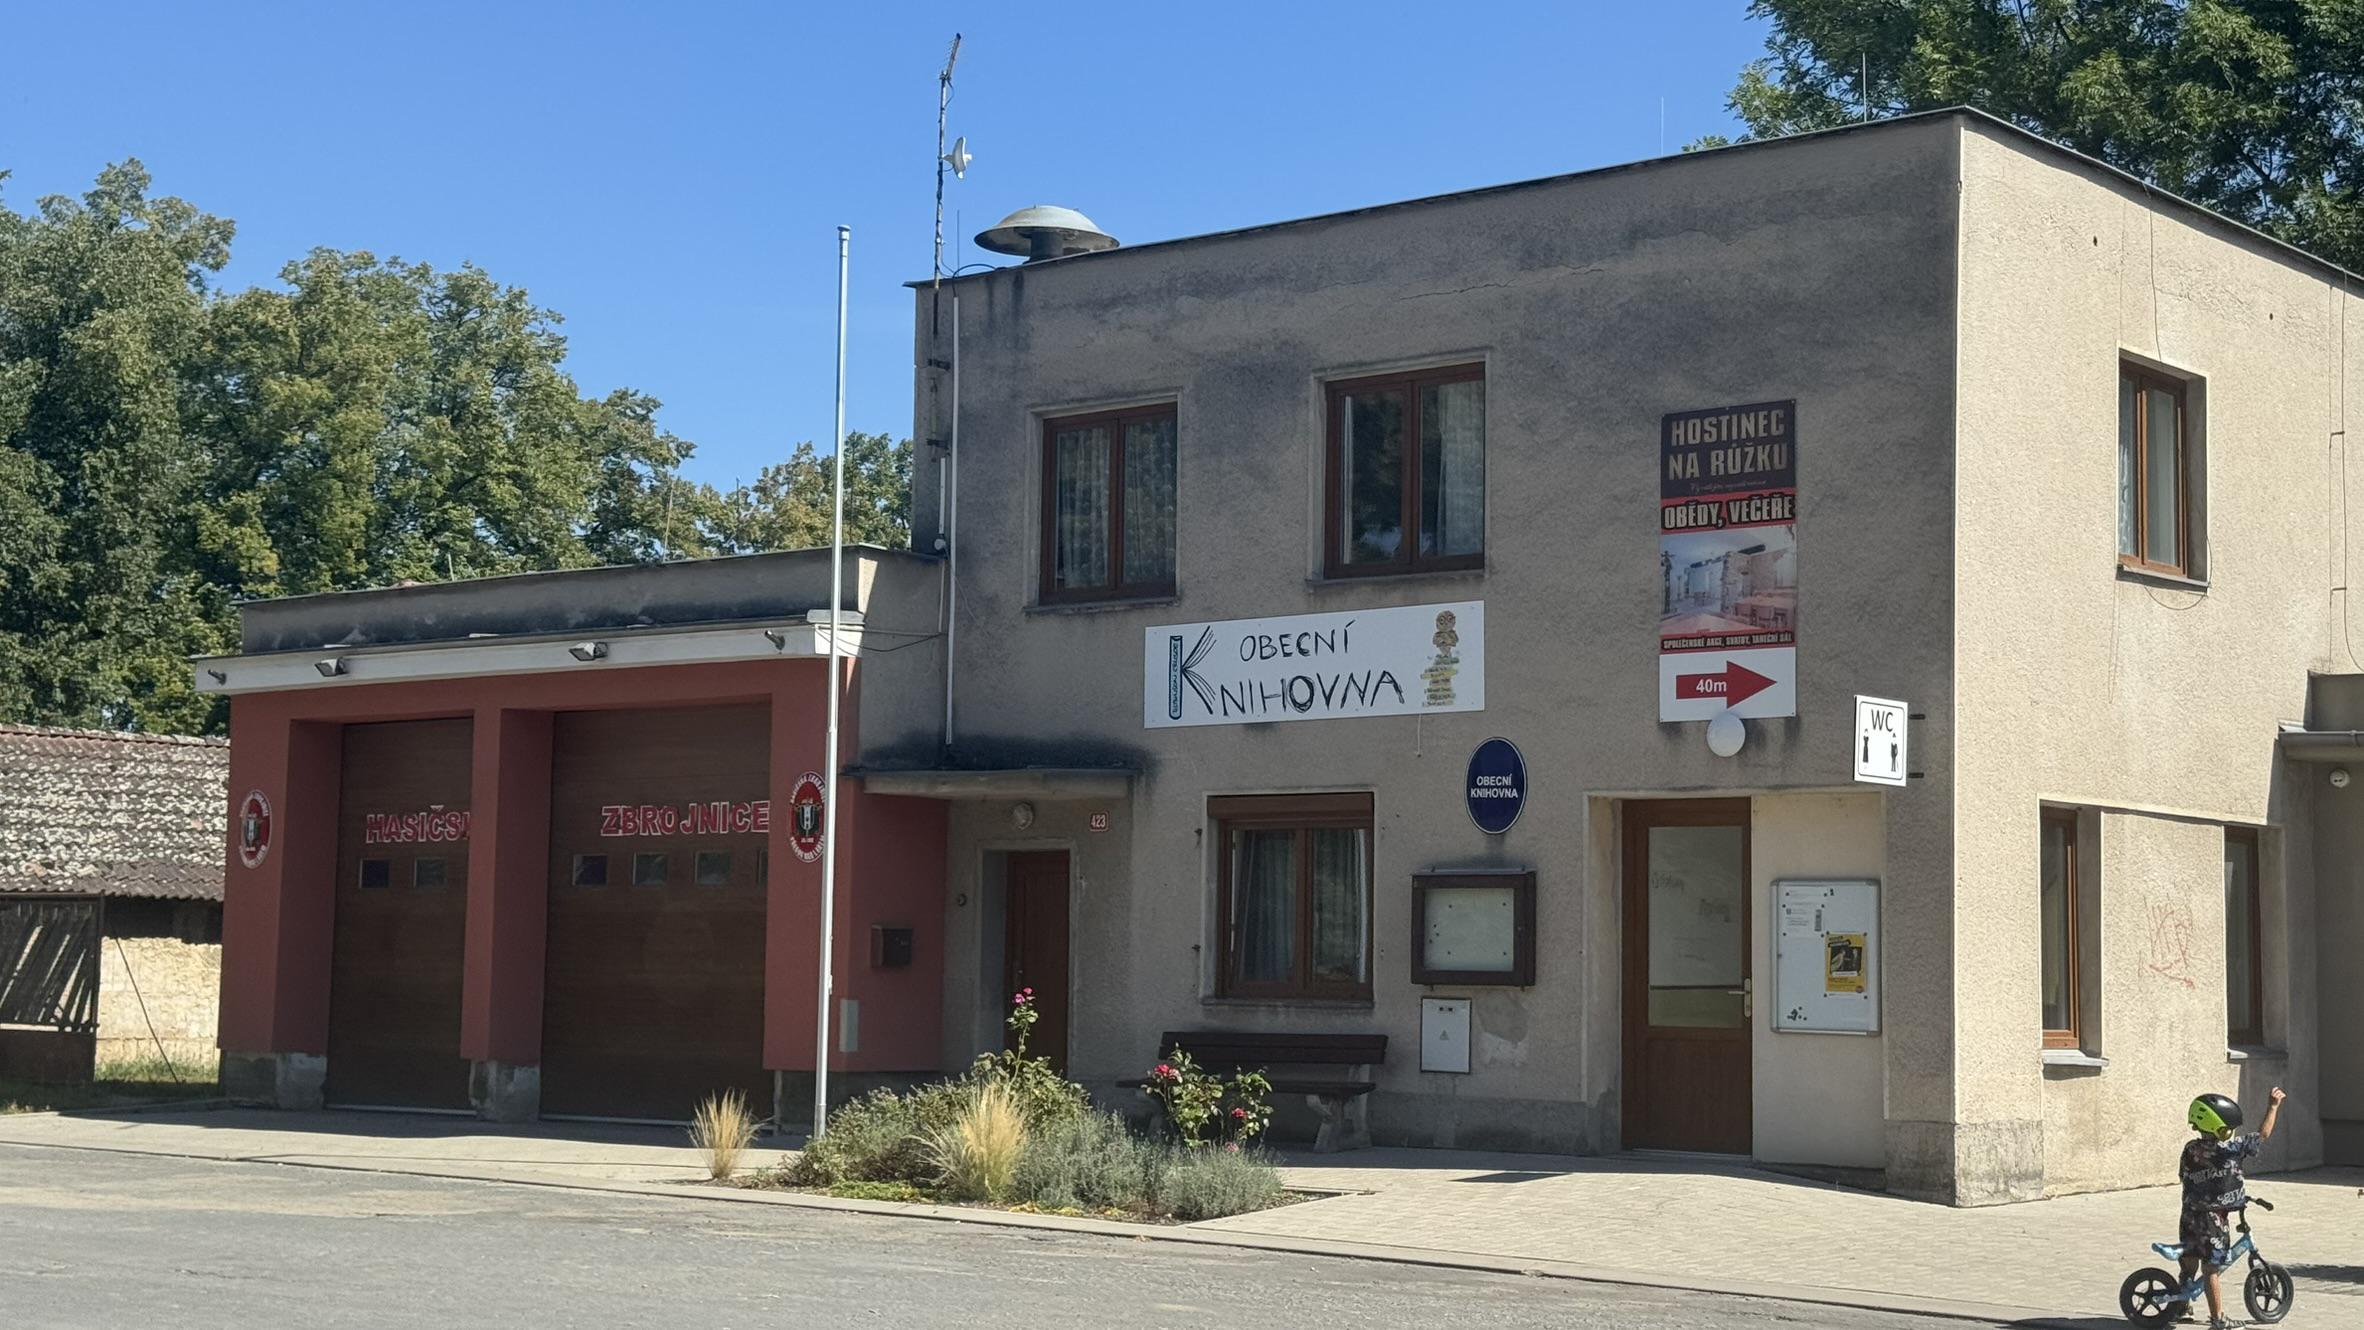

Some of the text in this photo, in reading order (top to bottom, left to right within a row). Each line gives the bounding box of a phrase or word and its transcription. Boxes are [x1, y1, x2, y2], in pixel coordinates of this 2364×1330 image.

[1671, 409, 1785, 446] HOSTINEC
[1668, 452, 1700, 480] NA
[1664, 496, 1794, 529] OBĚDY, VEČEŘE
[1239, 620, 1356, 662] OBECNÍ
[1169, 625, 1405, 720] KNIHOVNA
[1696, 679, 1727, 694] 40m
[1871, 709, 1894, 732] WC
[1471, 787, 1518, 799] KNIHOVNA
[1476, 773, 1512, 786] OBECNÍ
[600, 800, 770, 837] ZBROJNICE
[1091, 814, 1106, 828] 423
